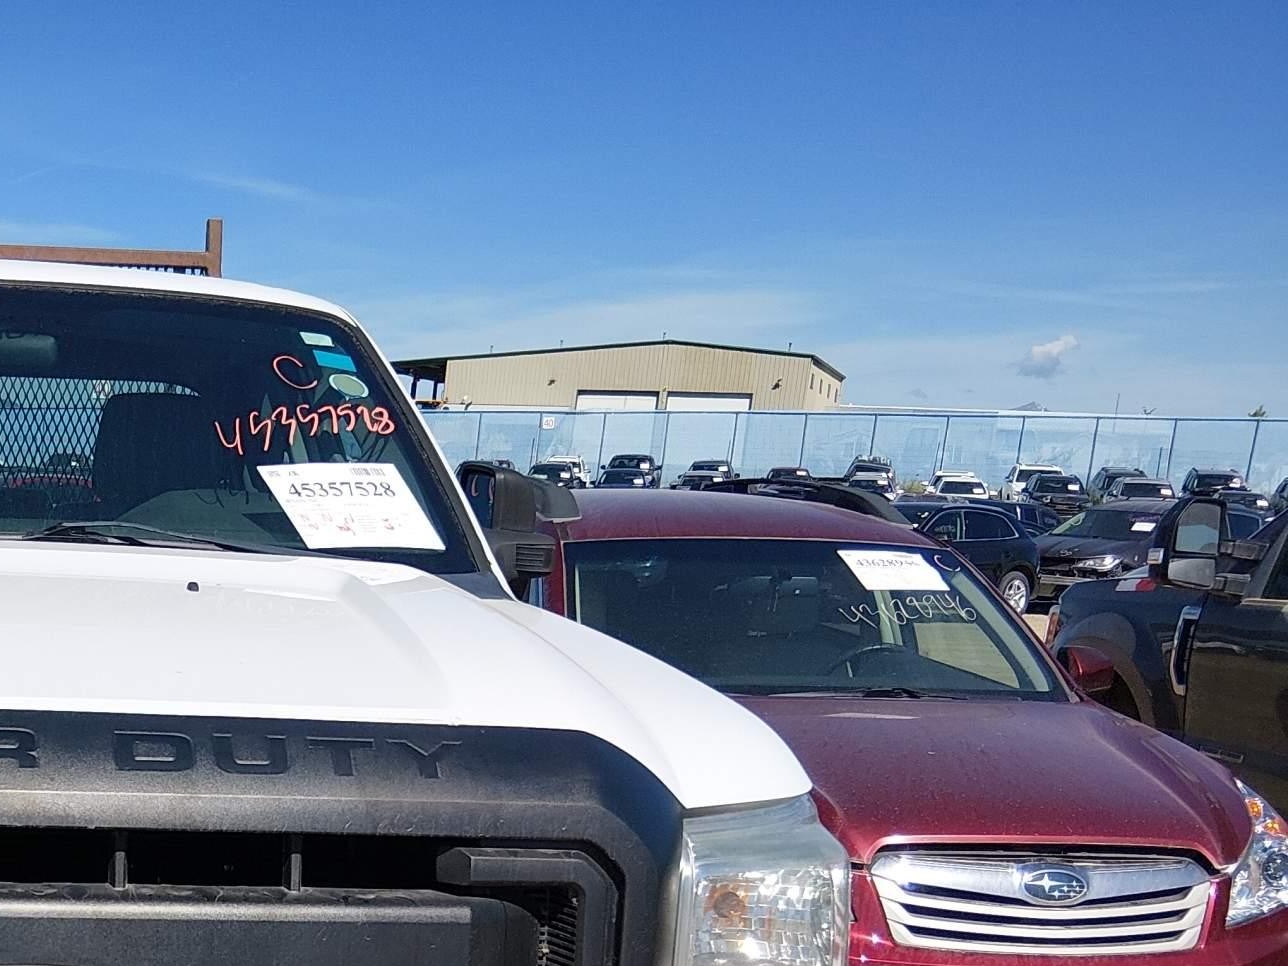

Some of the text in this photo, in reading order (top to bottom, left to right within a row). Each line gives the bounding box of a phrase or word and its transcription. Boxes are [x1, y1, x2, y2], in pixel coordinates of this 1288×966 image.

[272, 355, 318, 390] C
[214, 403, 396, 456] 45357528
[288, 481, 397, 498] 45357528
[934, 554, 961, 572] C
[113, 730, 462, 778] DUTY
